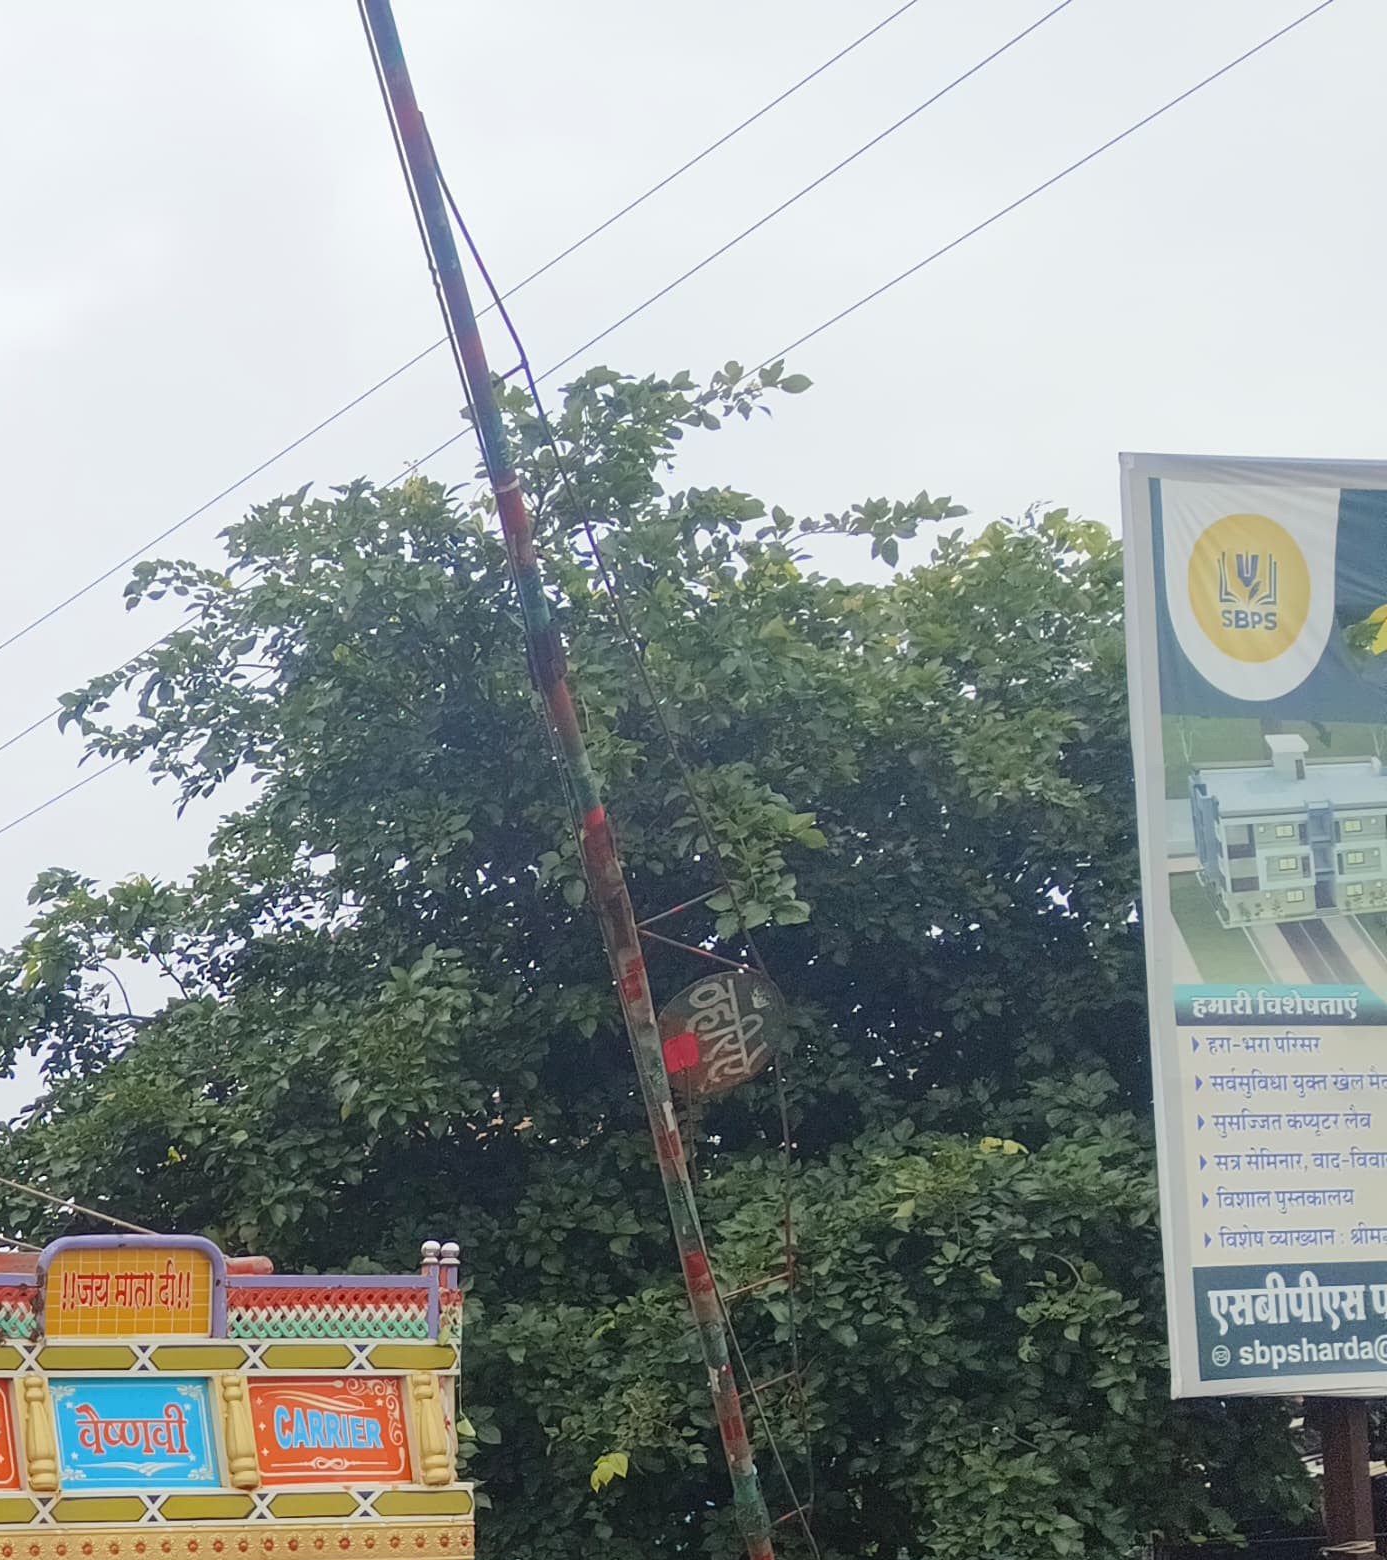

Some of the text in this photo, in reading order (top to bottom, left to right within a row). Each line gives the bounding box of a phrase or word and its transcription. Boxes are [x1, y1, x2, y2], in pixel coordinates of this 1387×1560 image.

[1221, 610, 1278, 631] SBPS
[1191, 990, 1253, 1018] हमारी
[1206, 1031, 1322, 1053] हरा-भरा परिसर
[1292, 1074, 1328, 1098] युक्त
[1331, 1067, 1364, 1091] खेल
[1211, 1108, 1282, 1138] सुसज्जित
[1311, 1146, 1387, 1172] वाद-विवा
[1216, 1186, 1354, 1214] विशाल पुस्तकालय
[1219, 1224, 1265, 1249] विशेष
[1267, 1229, 1335, 1247] व्याख्यान
[115, 1272, 154, 1310] माता
[1208, 1271, 1367, 1336] एसबीपीएस
[274, 1405, 384, 1450] CARRIER
